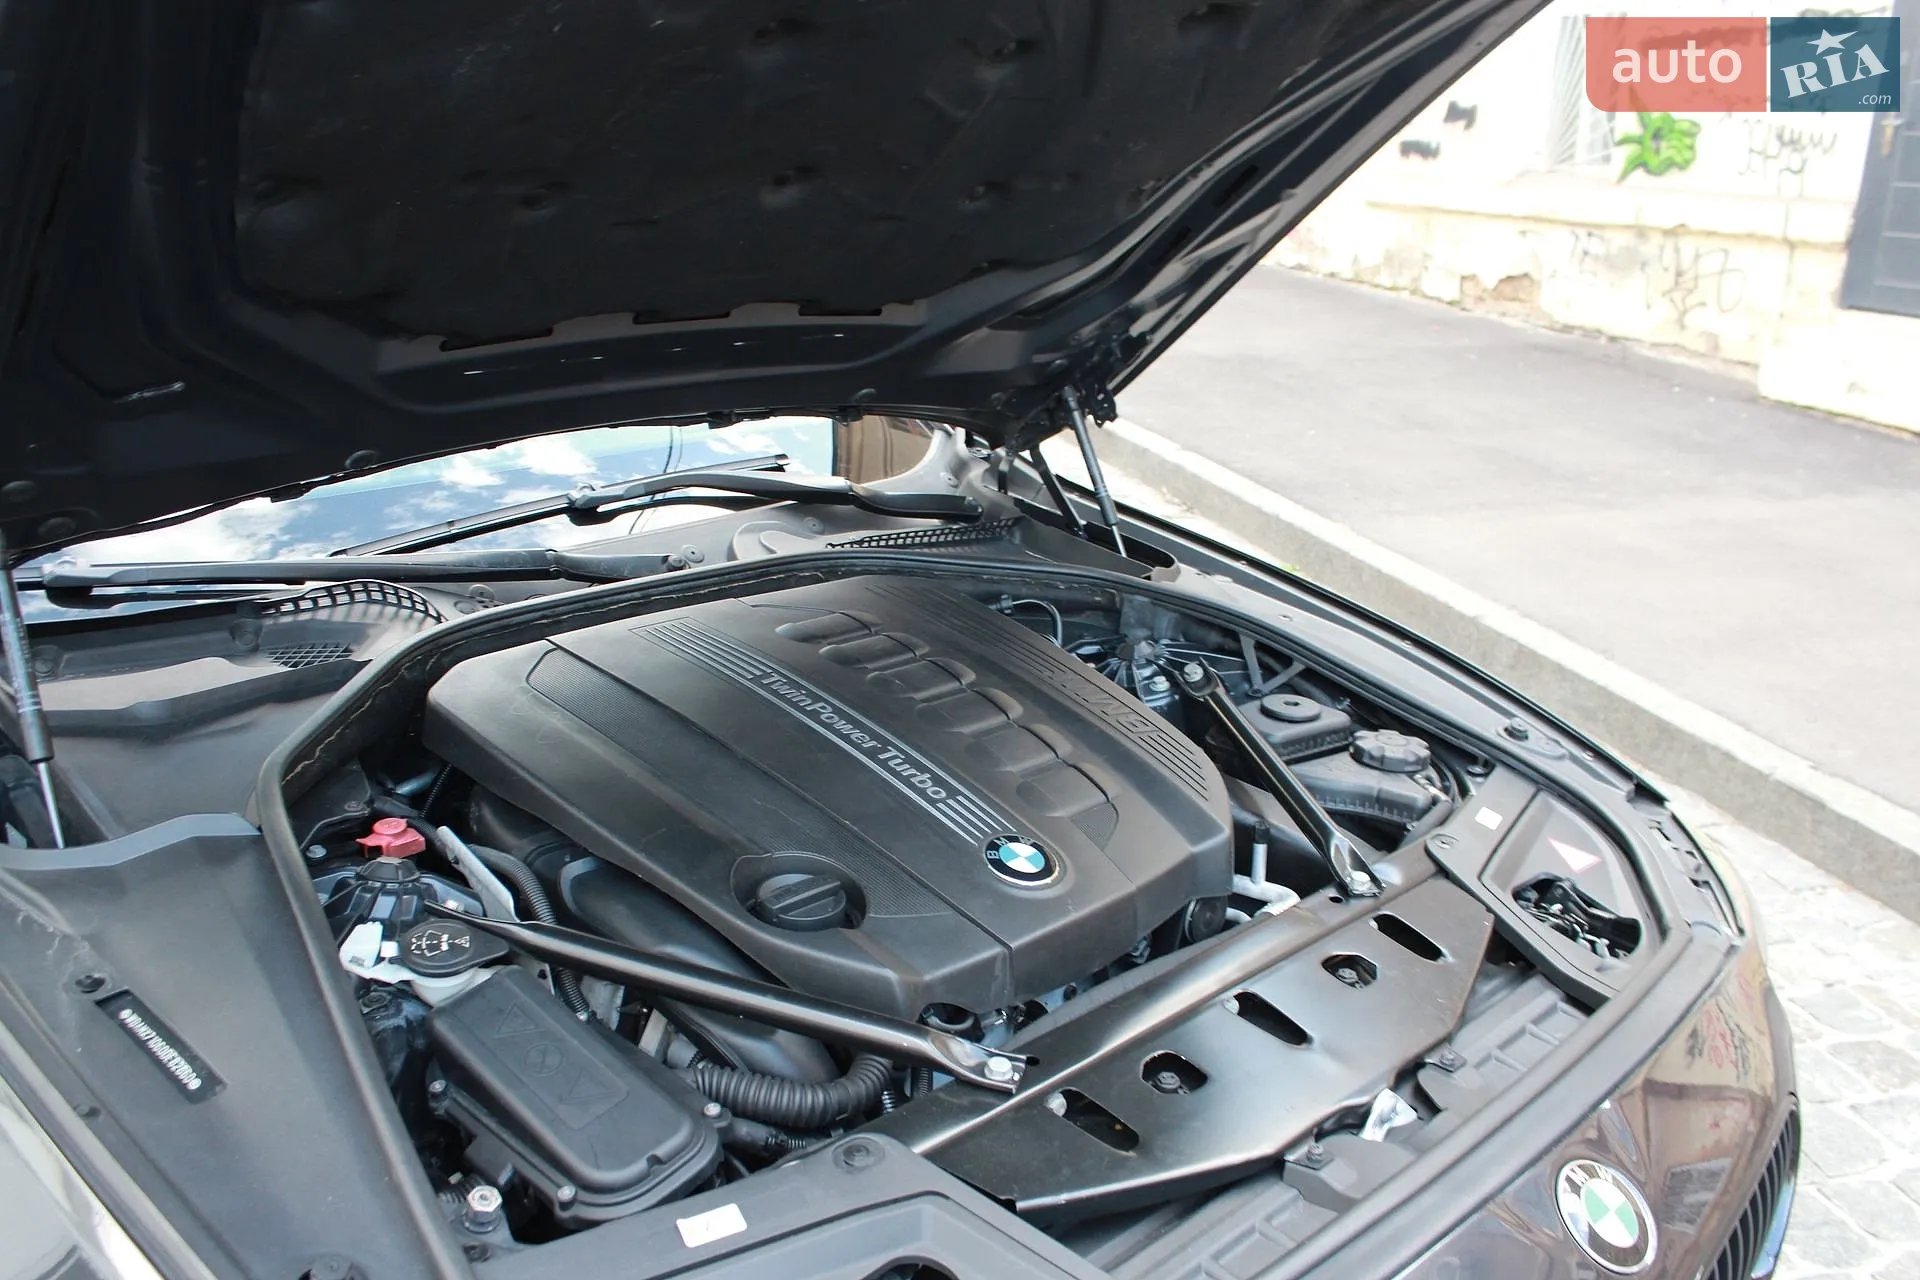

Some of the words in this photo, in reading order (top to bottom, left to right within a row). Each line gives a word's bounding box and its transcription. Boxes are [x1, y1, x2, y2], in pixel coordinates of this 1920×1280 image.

[762, 672, 882, 748] TwinPower
[878, 746, 947, 799] Turbo
[986, 836, 1034, 859] BMW
